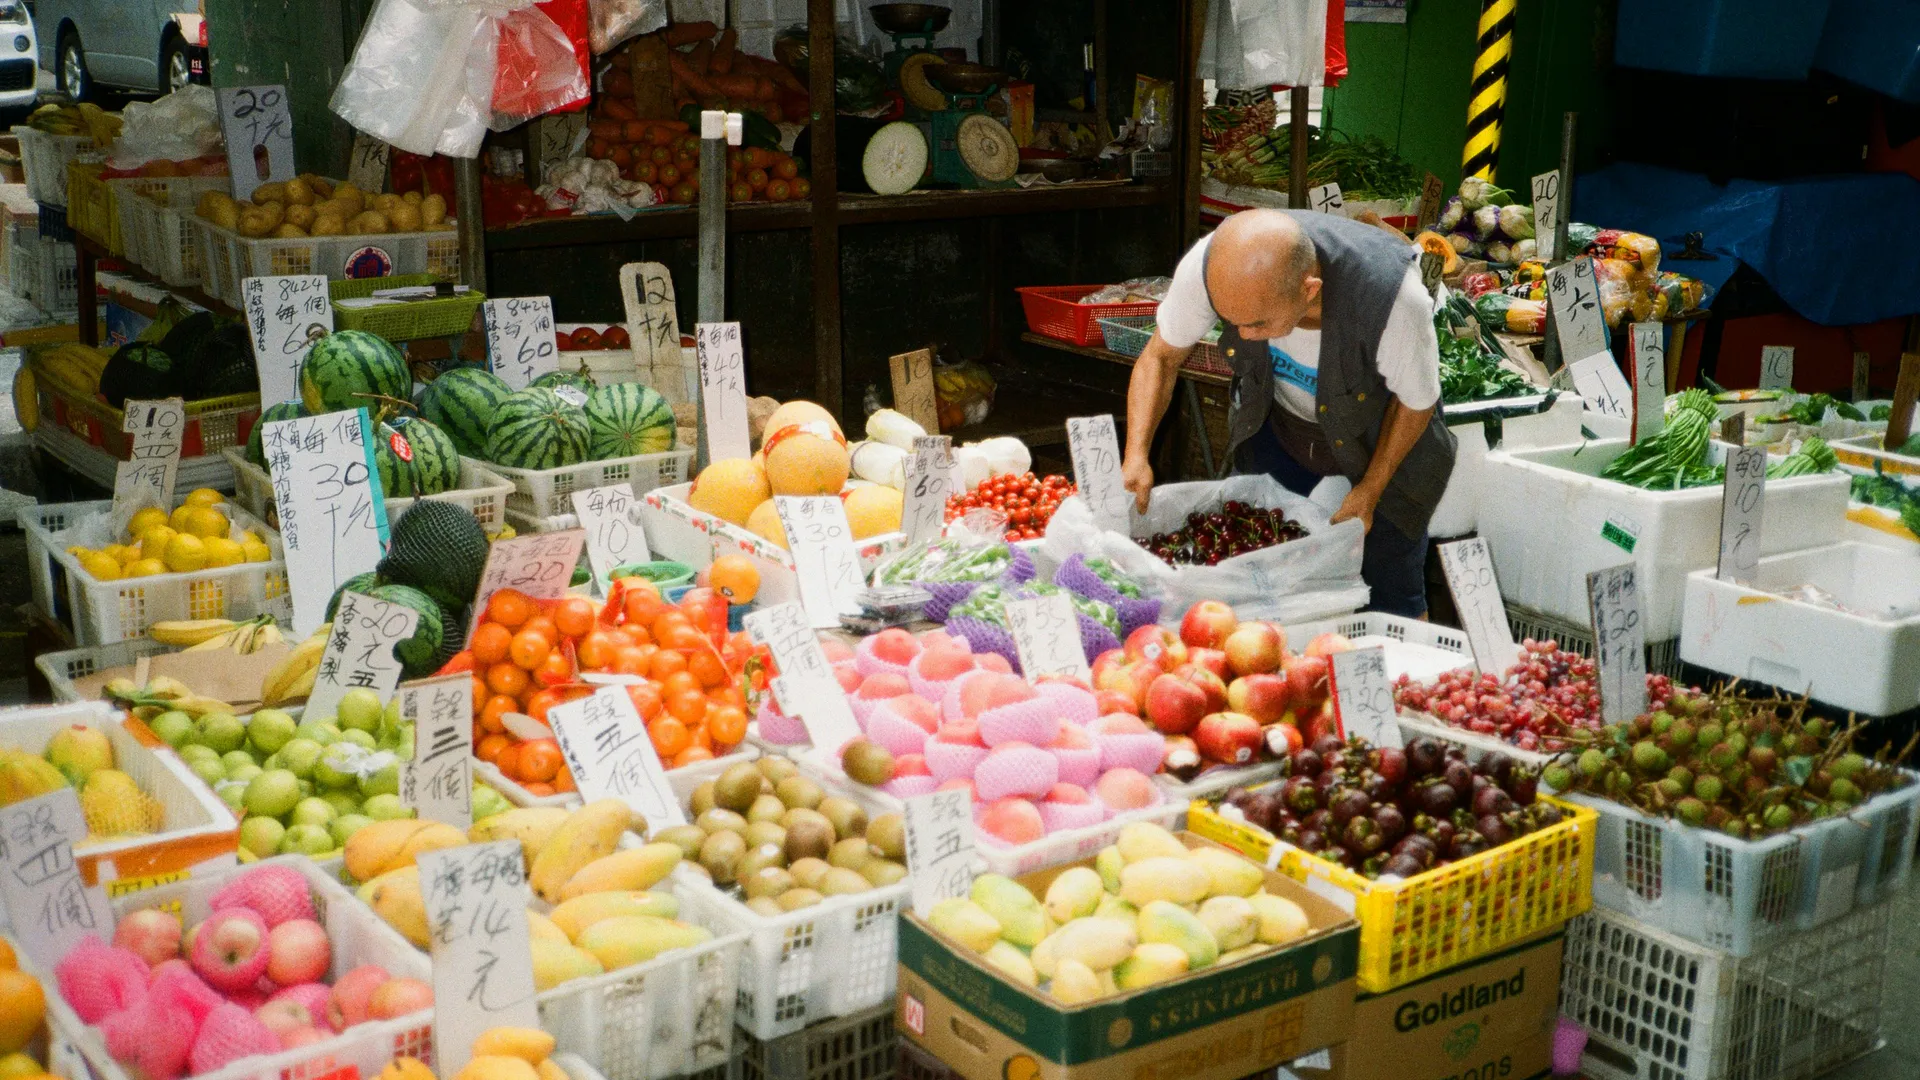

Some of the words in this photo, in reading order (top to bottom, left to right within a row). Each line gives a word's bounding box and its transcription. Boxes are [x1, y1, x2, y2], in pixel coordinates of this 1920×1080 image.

[234, 89, 281, 119] 20
[1318, 186, 1342, 214] 六
[1535, 174, 1559, 202] 20
[1424, 262, 1443, 280] 10
[278, 277, 323, 302] 8424
[635, 273, 676, 305] 12
[506, 298, 550, 317] 8424
[1566, 286, 1596, 323] 六
[282, 323, 316, 356] 6
[517, 336, 553, 364] 60
[1641, 330, 1664, 352] 12
[713, 353, 741, 374] 40
[904, 355, 931, 386] 10
[1766, 350, 1788, 379] 10
[145, 407, 178, 428] 10
[296, 414, 365, 454] 每個
[1089, 447, 1115, 475] 70
[308, 461, 370, 501] 30
[914, 474, 944, 498] 60
[587, 489, 632, 516] 每份
[1734, 483, 1761, 514] 10
[598, 518, 629, 554] 10
[805, 523, 842, 543] 30
[511, 561, 565, 586] 20
[1462, 567, 1492, 597] 20
[360, 601, 409, 638] 20
[1610, 609, 1640, 641] 20
[345, 669, 381, 690] 五
[432, 687, 463, 707] 50
[582, 693, 615, 715] 50
[1356, 686, 1391, 713] 20
[420, 725, 470, 765] 三
[594, 721, 642, 766] 五
[11, 804, 54, 842] 20
[929, 827, 976, 867] 五
[1393, 966, 1526, 1034] Goldland
